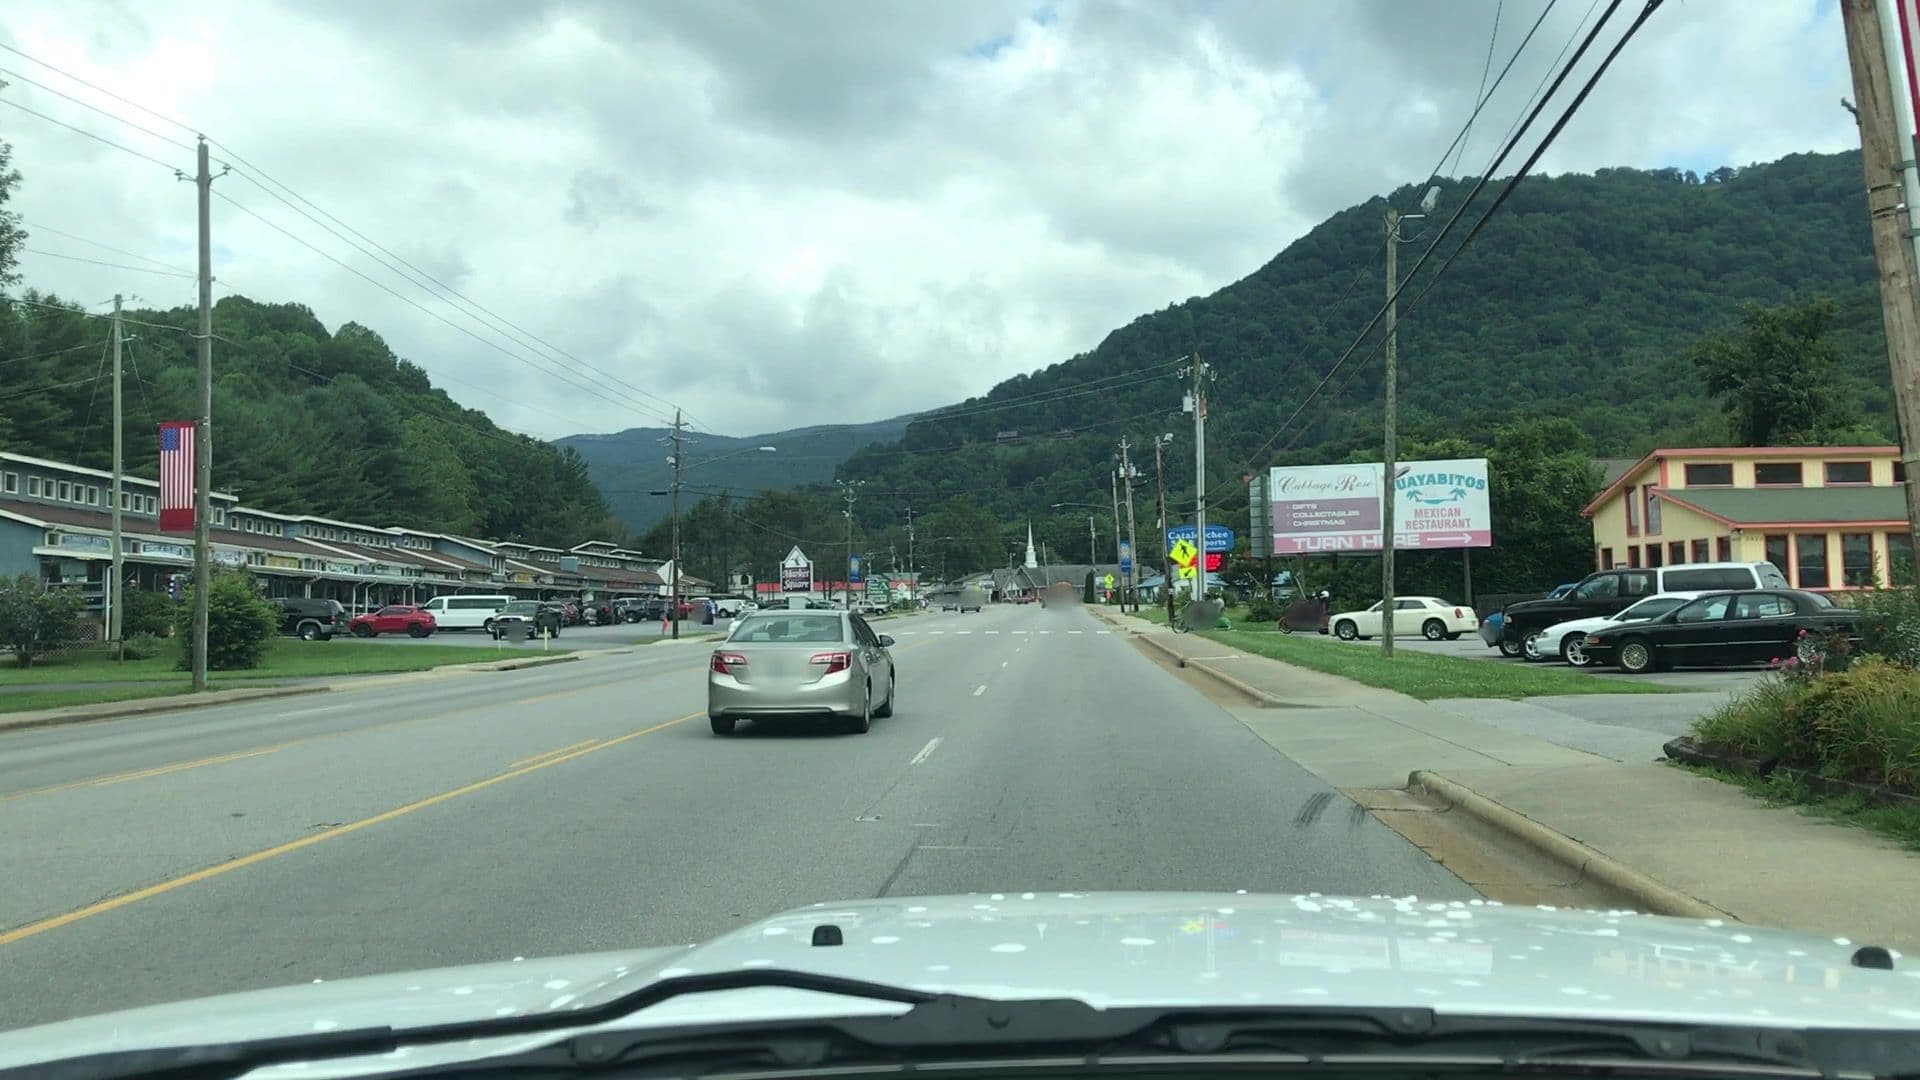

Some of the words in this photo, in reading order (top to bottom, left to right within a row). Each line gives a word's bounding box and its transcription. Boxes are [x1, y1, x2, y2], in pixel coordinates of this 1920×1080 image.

[1279, 475, 1332, 493] Cabbage
[1334, 474, 1372, 491] Rose
[1395, 473, 1485, 490] UAYABITOS
[1292, 510, 1360, 518] COLLECTABLES
[1414, 507, 1461, 518] MEXICAN
[1292, 519, 1345, 527] CHRISTMAS
[1405, 518, 1471, 530] RESTAURANT
[1168, 530, 1229, 540] Catalchee
[1293, 535, 1353, 550] TURN
[783, 580, 809, 590] Square
